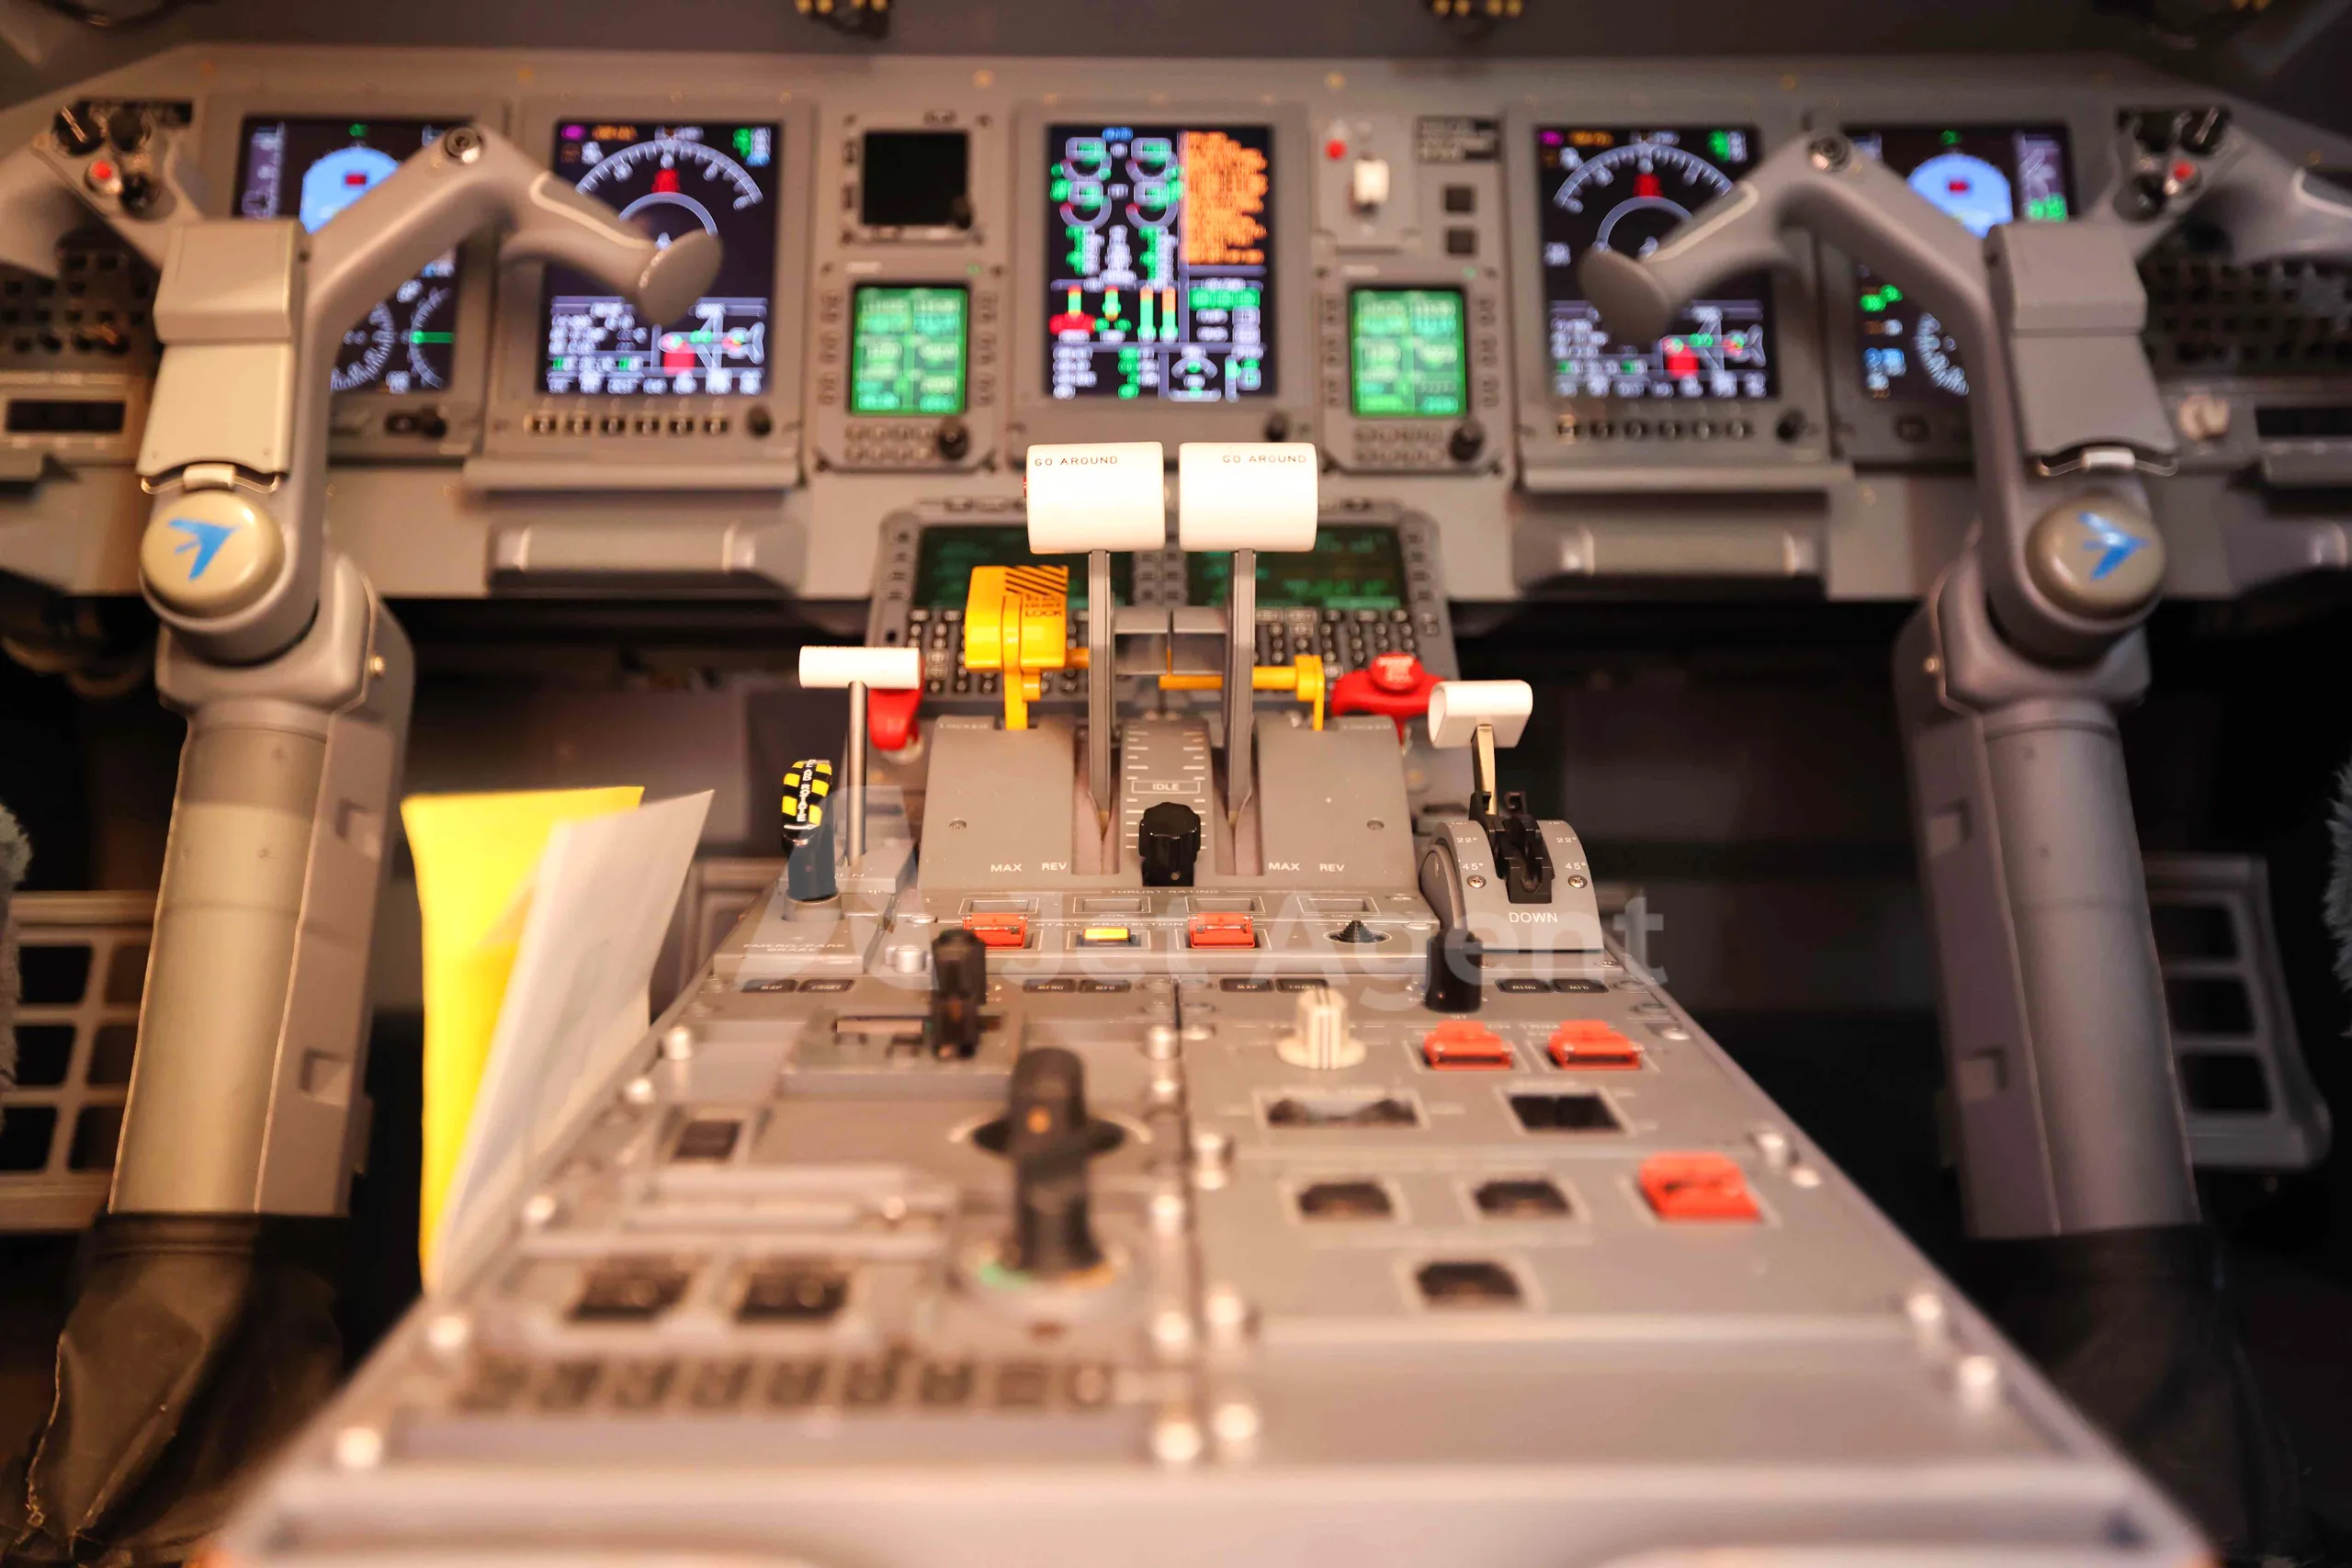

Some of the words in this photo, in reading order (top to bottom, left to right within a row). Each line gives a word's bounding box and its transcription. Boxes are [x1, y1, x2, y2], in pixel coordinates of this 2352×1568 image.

[1035, 457, 1053, 467] GO
[1060, 456, 1118, 466] AROUND
[1222, 455, 1241, 464] GO
[1249, 455, 1306, 464] AROUND
[1152, 783, 1180, 791] IDLE
[990, 863, 1023, 873] MAX
[1042, 863, 1068, 871] REV
[1268, 863, 1301, 872] MAX
[1319, 863, 1345, 872] REV
[1462, 862, 1484, 871] 45°
[1565, 862, 1587, 871] 45°
[1509, 912, 1558, 923] DOWN
